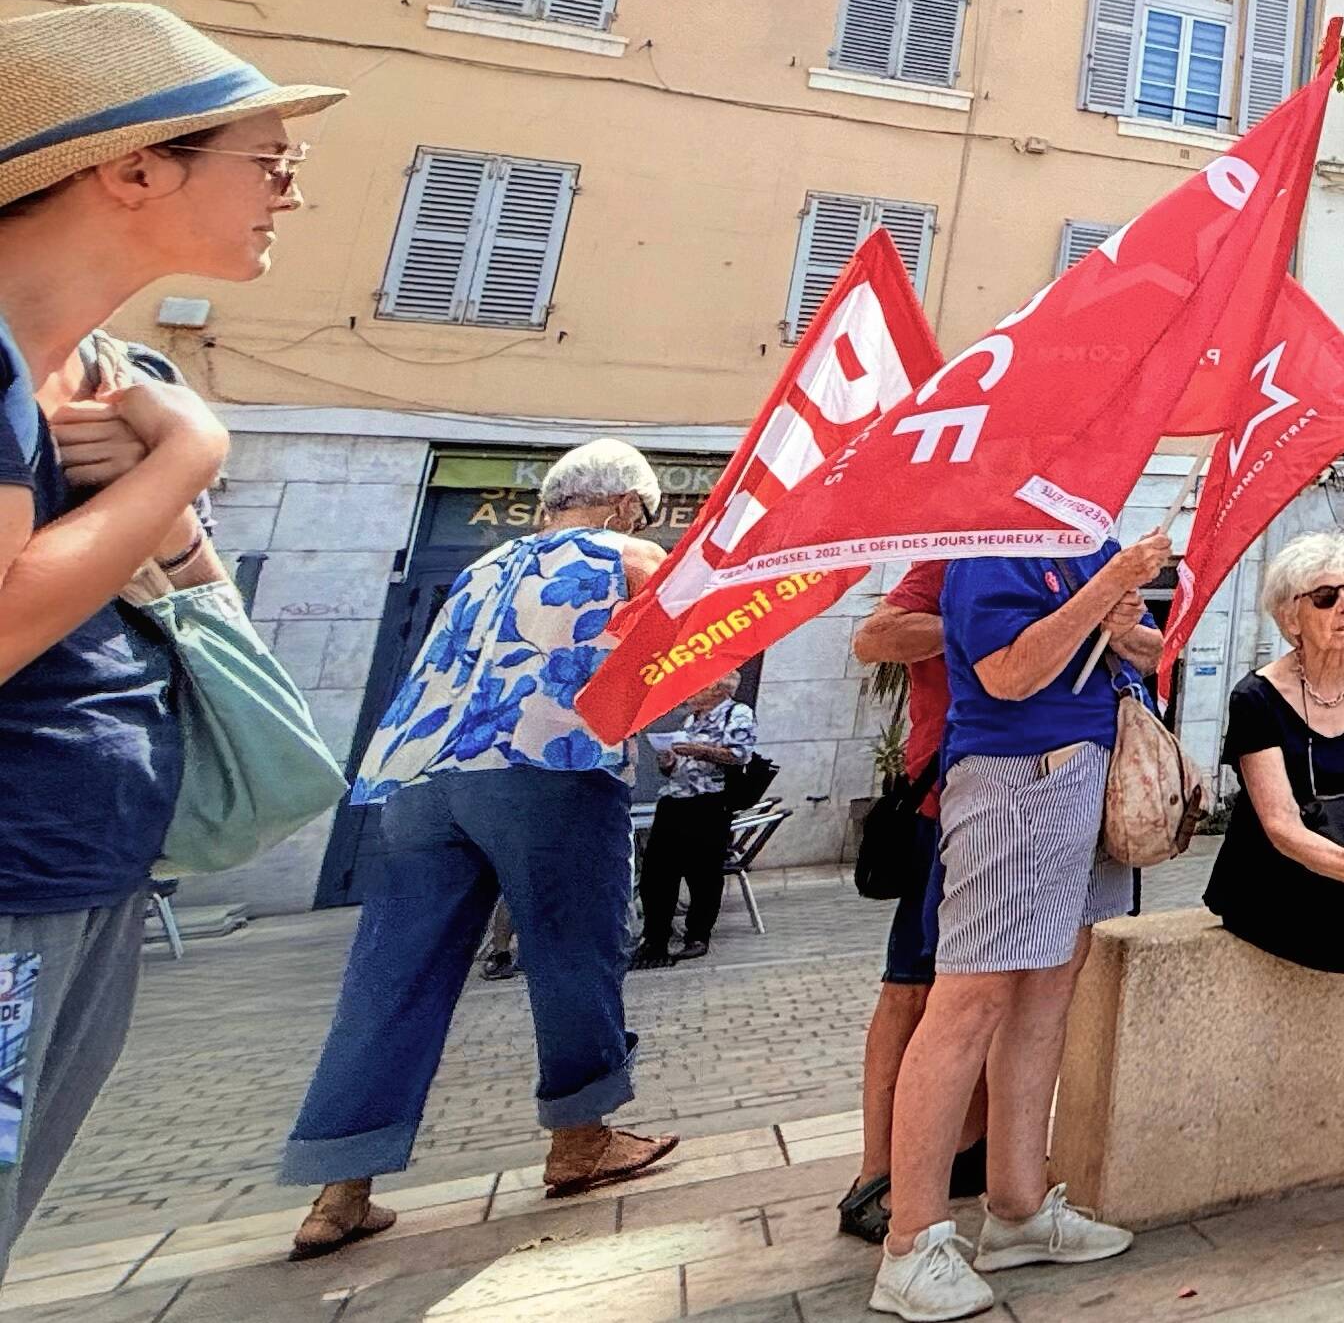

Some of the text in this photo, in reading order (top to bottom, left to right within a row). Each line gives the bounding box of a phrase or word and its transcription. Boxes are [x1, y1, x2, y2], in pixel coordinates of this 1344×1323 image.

[815, 546, 841, 559] 2022
[851, 543, 867, 554] LE
[870, 539, 898, 552] DÉFI
[902, 537, 928, 549] DES
[931, 534, 974, 547] JOURS
[977, 533, 1044, 546] HEUREUX
